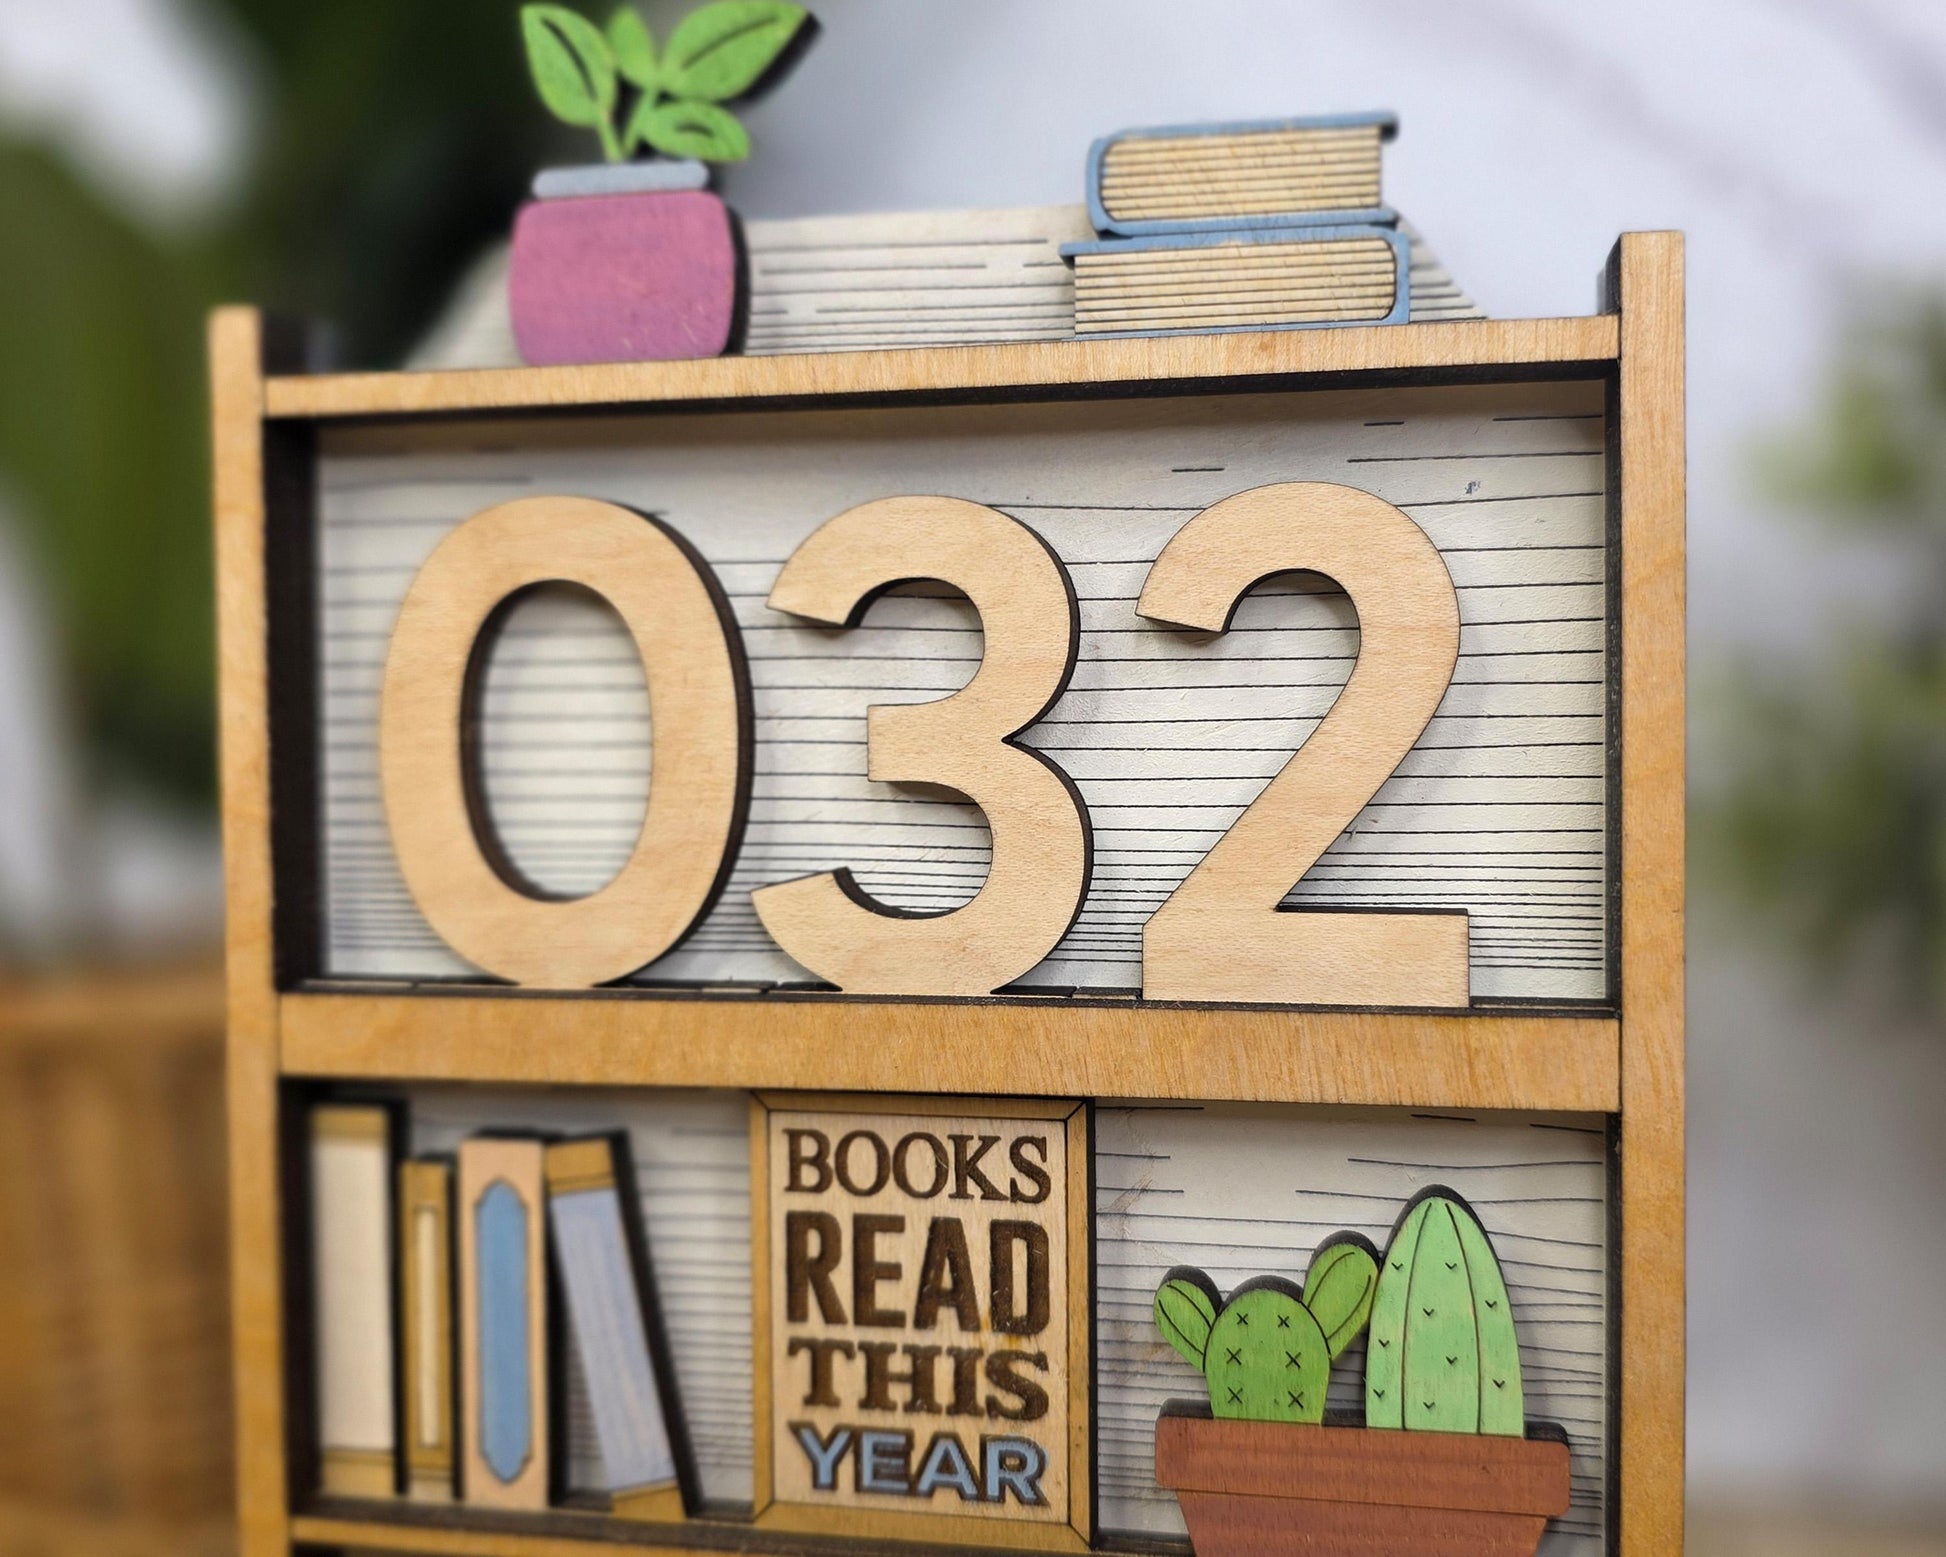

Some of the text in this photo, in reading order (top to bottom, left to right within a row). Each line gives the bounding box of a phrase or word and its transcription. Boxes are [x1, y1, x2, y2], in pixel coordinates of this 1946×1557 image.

[380, 481, 1470, 1008] 032
[782, 1128, 1051, 1203] BOOKS
[786, 1210, 1050, 1336] READ
[788, 1337, 1050, 1421] THIS
[788, 1420, 1050, 1507] YEAR
